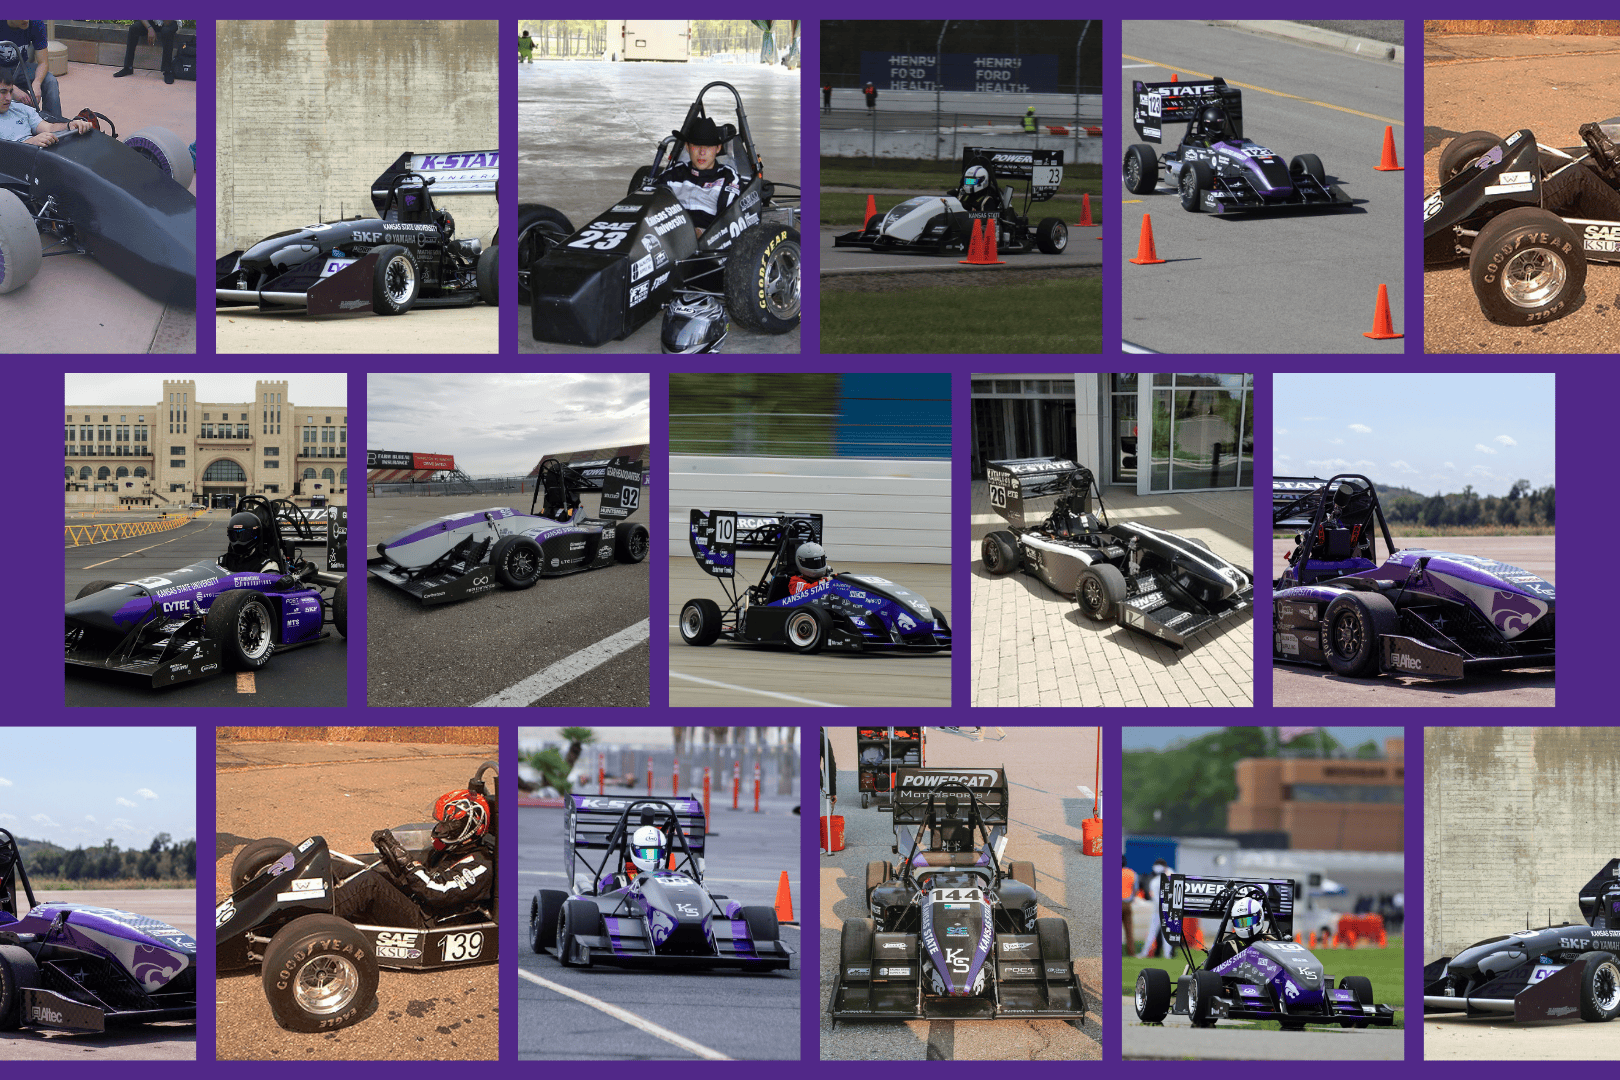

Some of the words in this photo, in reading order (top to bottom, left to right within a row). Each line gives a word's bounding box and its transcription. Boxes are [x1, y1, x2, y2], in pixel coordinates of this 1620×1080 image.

[888, 55, 936, 67] HENRY
[973, 57, 1022, 69] HENRY
[890, 68, 926, 79] FORD
[975, 70, 1012, 81] FORD
[1149, 97, 1161, 114] 123
[1048, 168, 1060, 183] 23
[644, 211, 669, 228] Kansas
[664, 203, 683, 217] State
[589, 222, 637, 231] SAE
[654, 214, 687, 237] University
[1584, 226, 1620, 241] SAE
[352, 231, 382, 243] SKF
[392, 234, 416, 244] YAMAHA
[567, 231, 628, 250] 23
[1585, 241, 1614, 250] KSU
[1484, 232, 1572, 284] GOODYEAR
[758, 231, 778, 309] GOODYEAR
[1526, 301, 1565, 322] EAGLE
[622, 488, 638, 507] 92
[991, 487, 1005, 506] 26
[718, 519, 737, 540] 10
[156, 586, 178, 598] KANSAS
[177, 583, 192, 595] STATE
[190, 576, 219, 590] UNIVERSITY
[782, 588, 811, 606] KANSAS
[810, 581, 831, 597] STATE
[163, 600, 190, 612] CYTEC
[1400, 653, 1422, 670] Altec
[902, 775, 989, 787] POWERCAT
[931, 889, 981, 901] 144
[1174, 883, 1182, 906] 10
[676, 903, 700, 917] KS
[946, 926, 968, 935] SAE
[376, 932, 419, 947] SAE
[438, 932, 483, 961] 139
[923, 928, 939, 955] STATE
[1560, 937, 1590, 949] SKF
[377, 947, 407, 958] KSU
[945, 948, 970, 973] KS
[276, 939, 365, 990] GOODYEAR
[1212, 957, 1233, 973] KANSAS
[1232, 949, 1247, 963] STATE
[1297, 966, 1318, 980] KS
[42, 1007, 63, 1023] Altec
[318, 1007, 357, 1028] EAGLE
